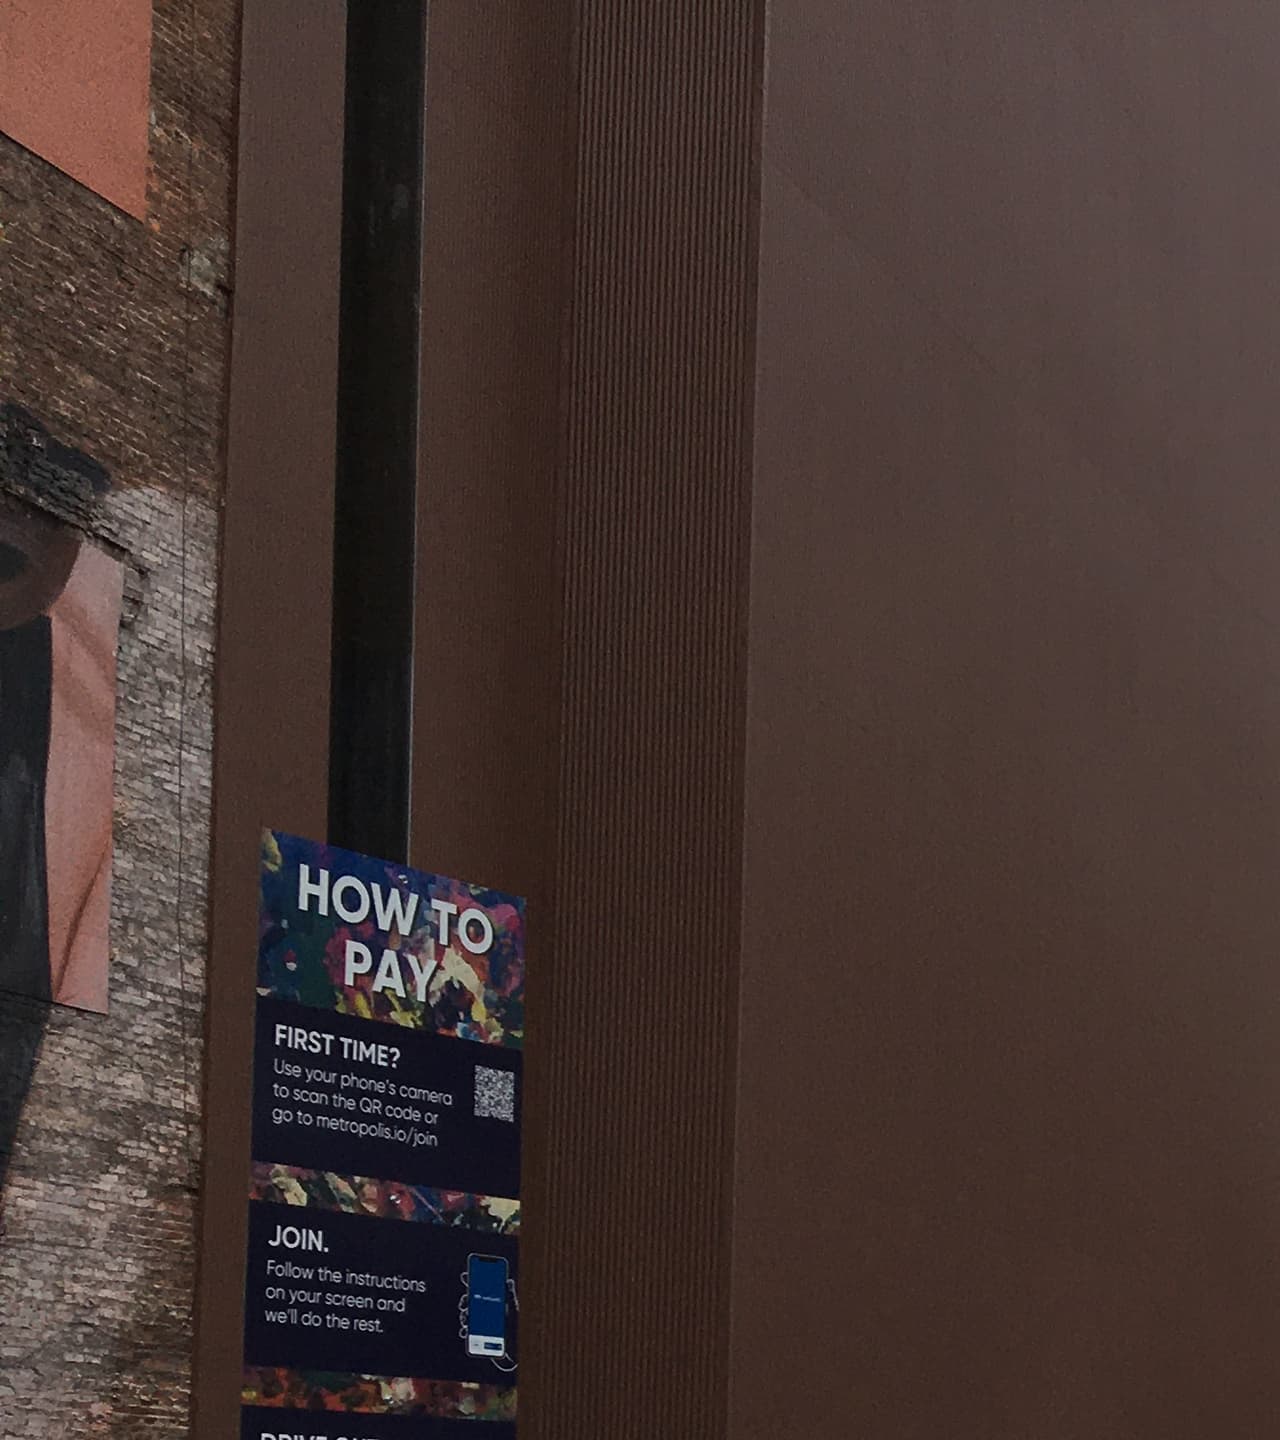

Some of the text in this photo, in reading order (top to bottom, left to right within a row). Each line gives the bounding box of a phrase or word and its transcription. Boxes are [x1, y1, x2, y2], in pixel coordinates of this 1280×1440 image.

[298, 863, 495, 955] HOW TO
[344, 940, 437, 1003] PAY
[275, 1024, 400, 1069] FIRST TIME?
[274, 1058, 453, 1106] Use your phone's camera
[273, 1083, 439, 1125] to scan the QR code or
[271, 1109, 438, 1148] go to metropolis.io/join
[268, 1225, 329, 1253] JOIN.
[266, 1260, 426, 1293] Follow the instructions
[265, 1286, 406, 1312] on your screen and
[265, 1308, 384, 1333] we'll do the rest.
